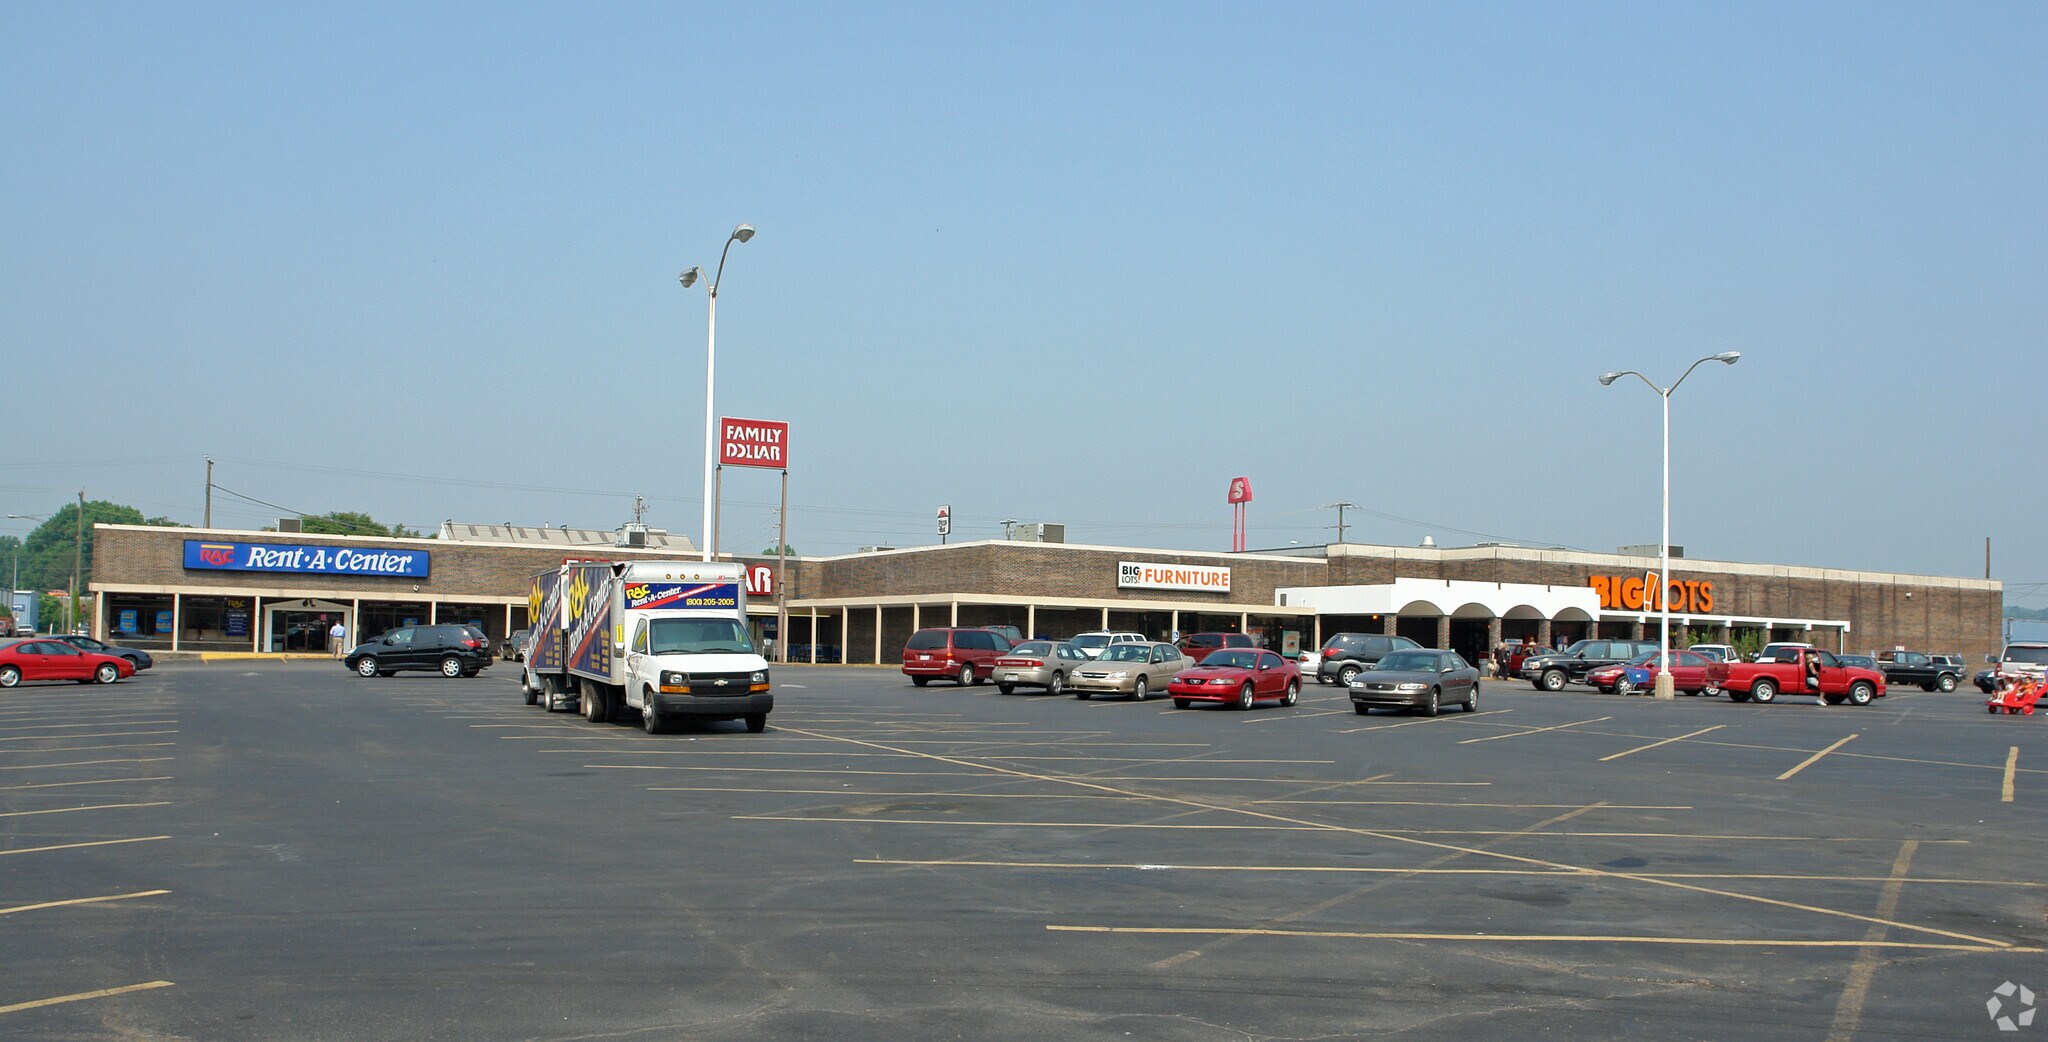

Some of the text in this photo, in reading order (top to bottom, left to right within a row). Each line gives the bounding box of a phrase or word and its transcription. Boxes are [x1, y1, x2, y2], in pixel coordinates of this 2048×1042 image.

[726, 425, 783, 444] FAMILY
[726, 442, 781, 461] DOLLAR
[200, 549, 235, 566] RAC
[1122, 565, 1140, 576] BIG
[1145, 568, 1229, 587] FURNITURE
[625, 584, 651, 600] RAC
[686, 598, 735, 606] (800) 205-2005
